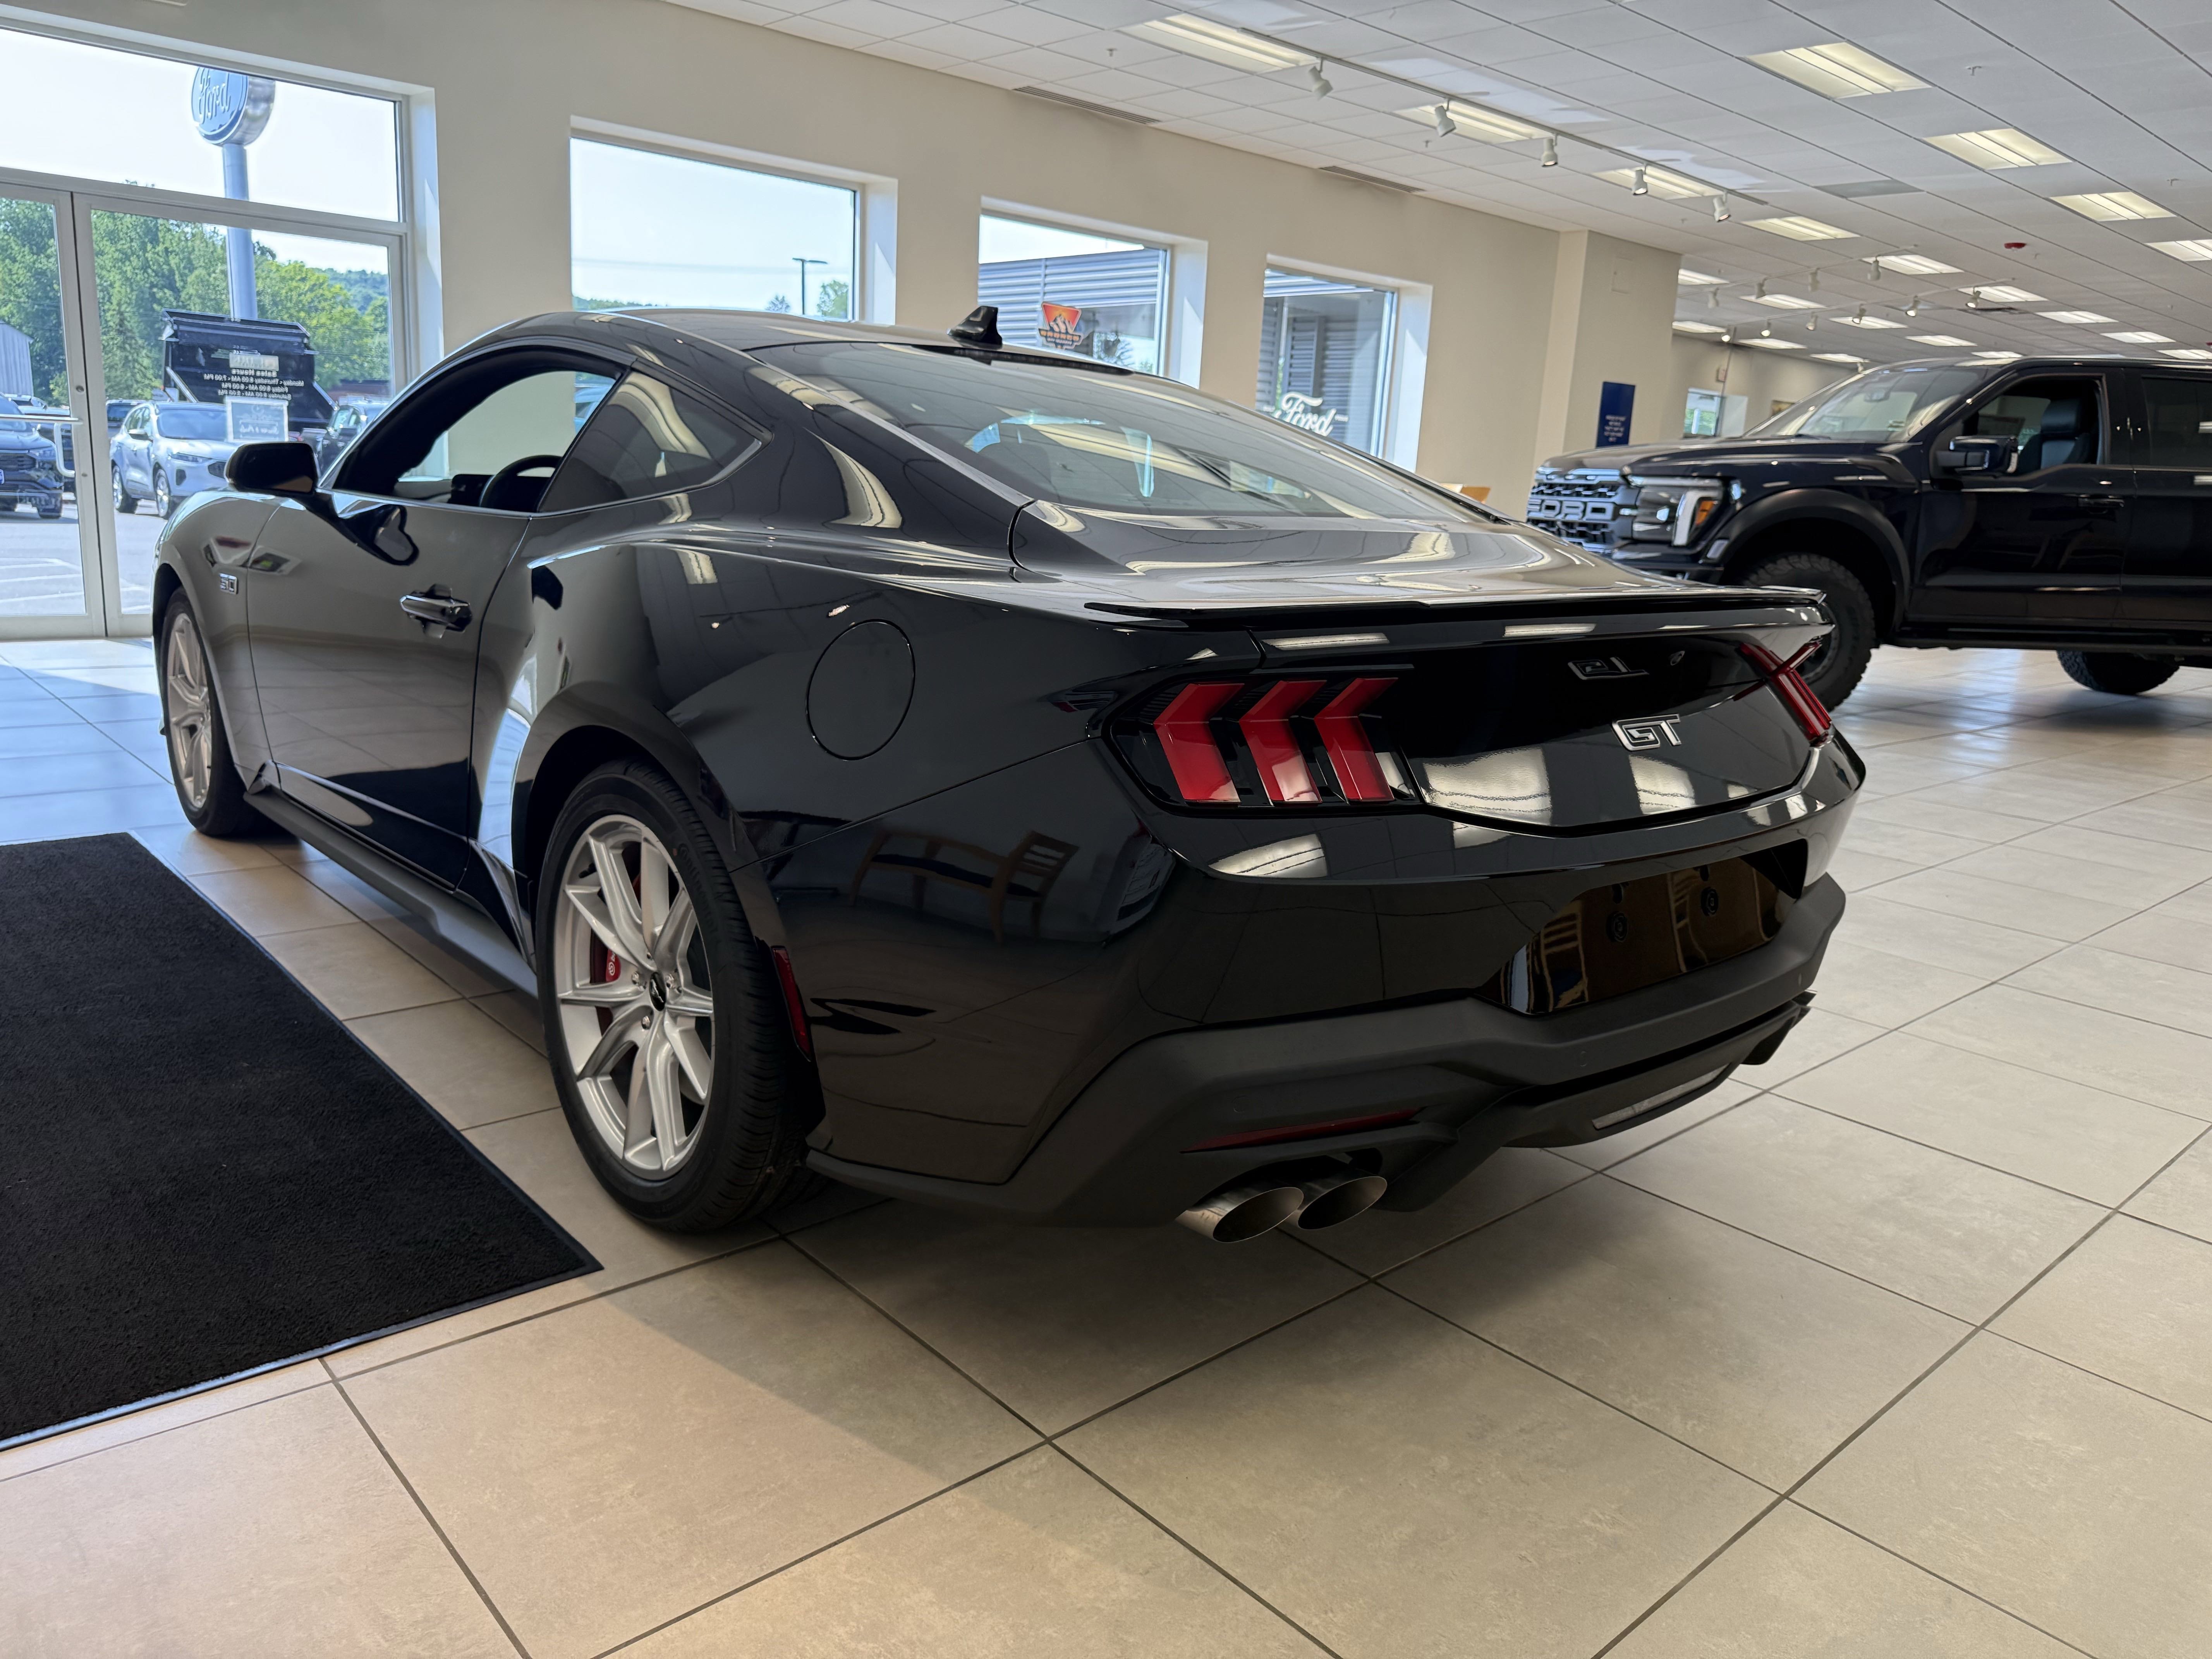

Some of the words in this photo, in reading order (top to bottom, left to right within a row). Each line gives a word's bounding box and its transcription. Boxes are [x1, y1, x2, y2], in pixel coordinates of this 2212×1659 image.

[1273, 391, 1337, 436] Ford
[1527, 498, 1615, 521] FORD
[1611, 714, 1682, 752] GT
